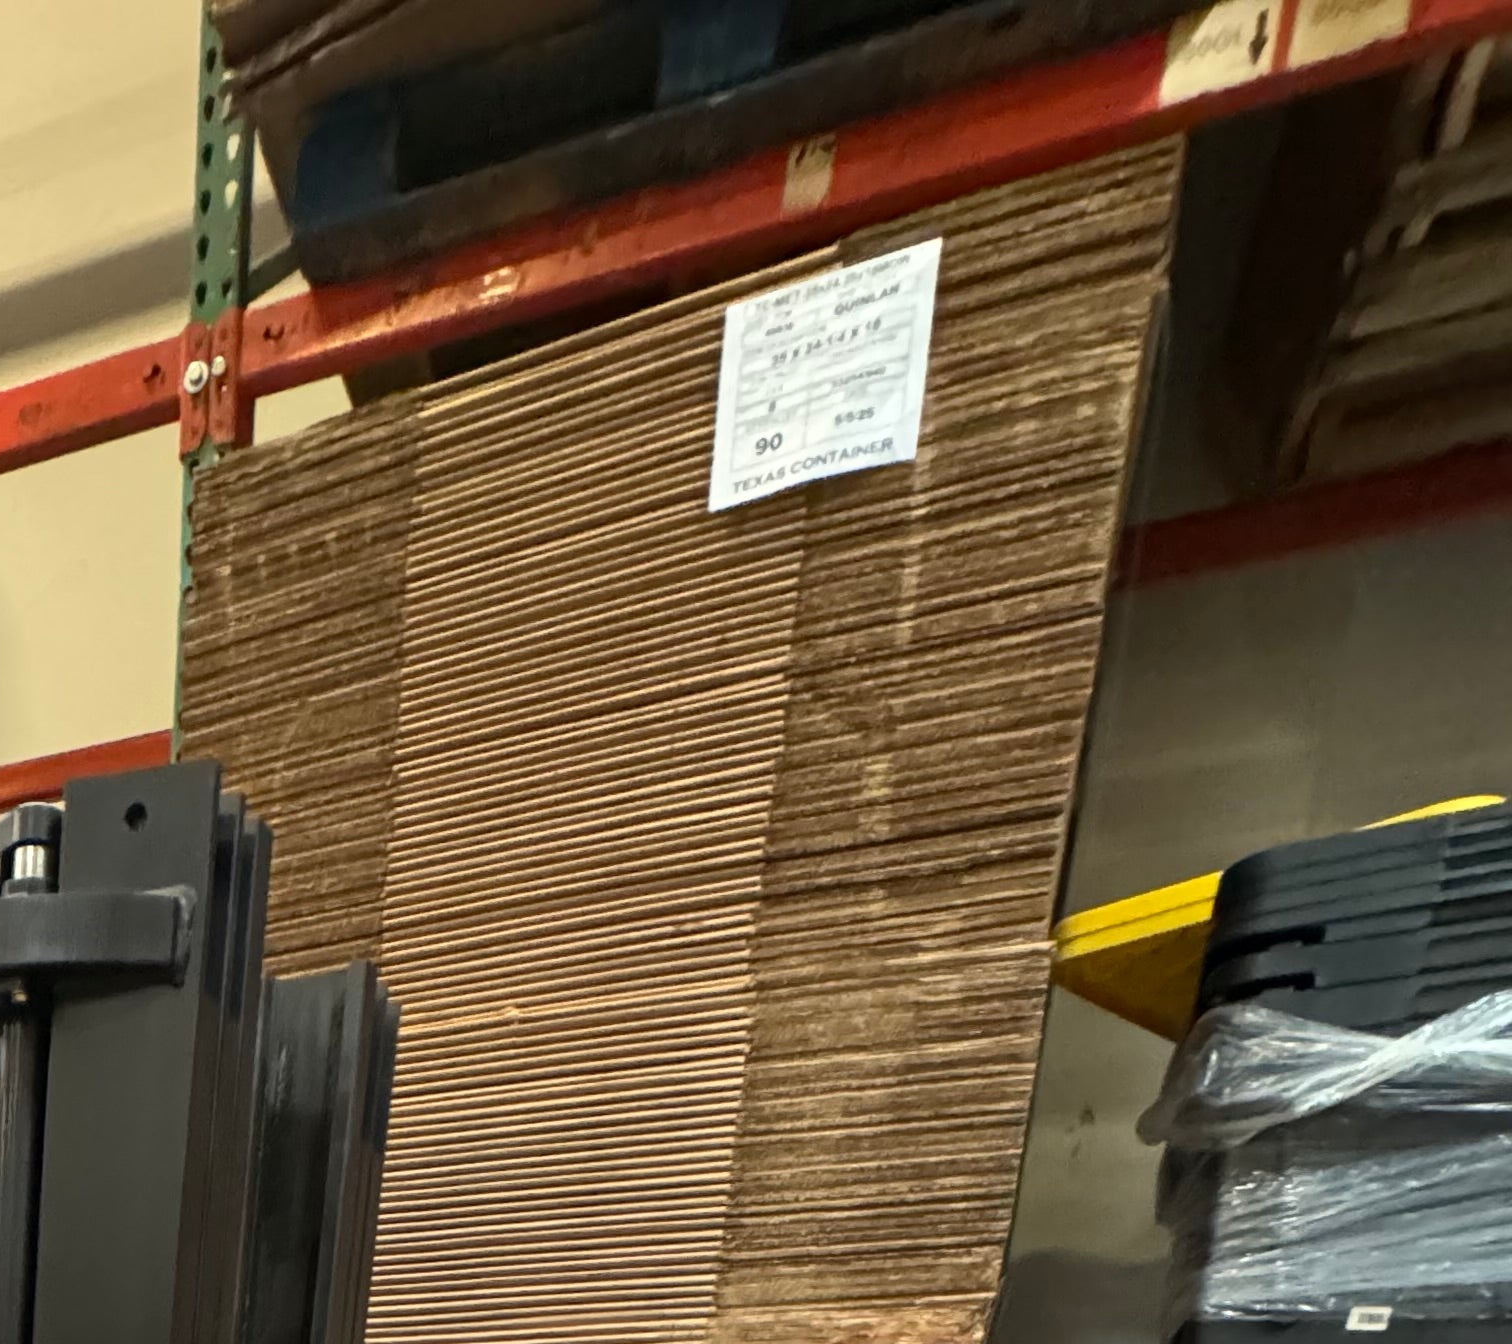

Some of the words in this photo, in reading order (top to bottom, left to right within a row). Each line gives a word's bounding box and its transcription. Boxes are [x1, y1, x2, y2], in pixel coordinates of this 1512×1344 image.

[755, 432, 784, 456] 90
[732, 465, 787, 495] TEXAS
[790, 437, 894, 475] CONTAINER
